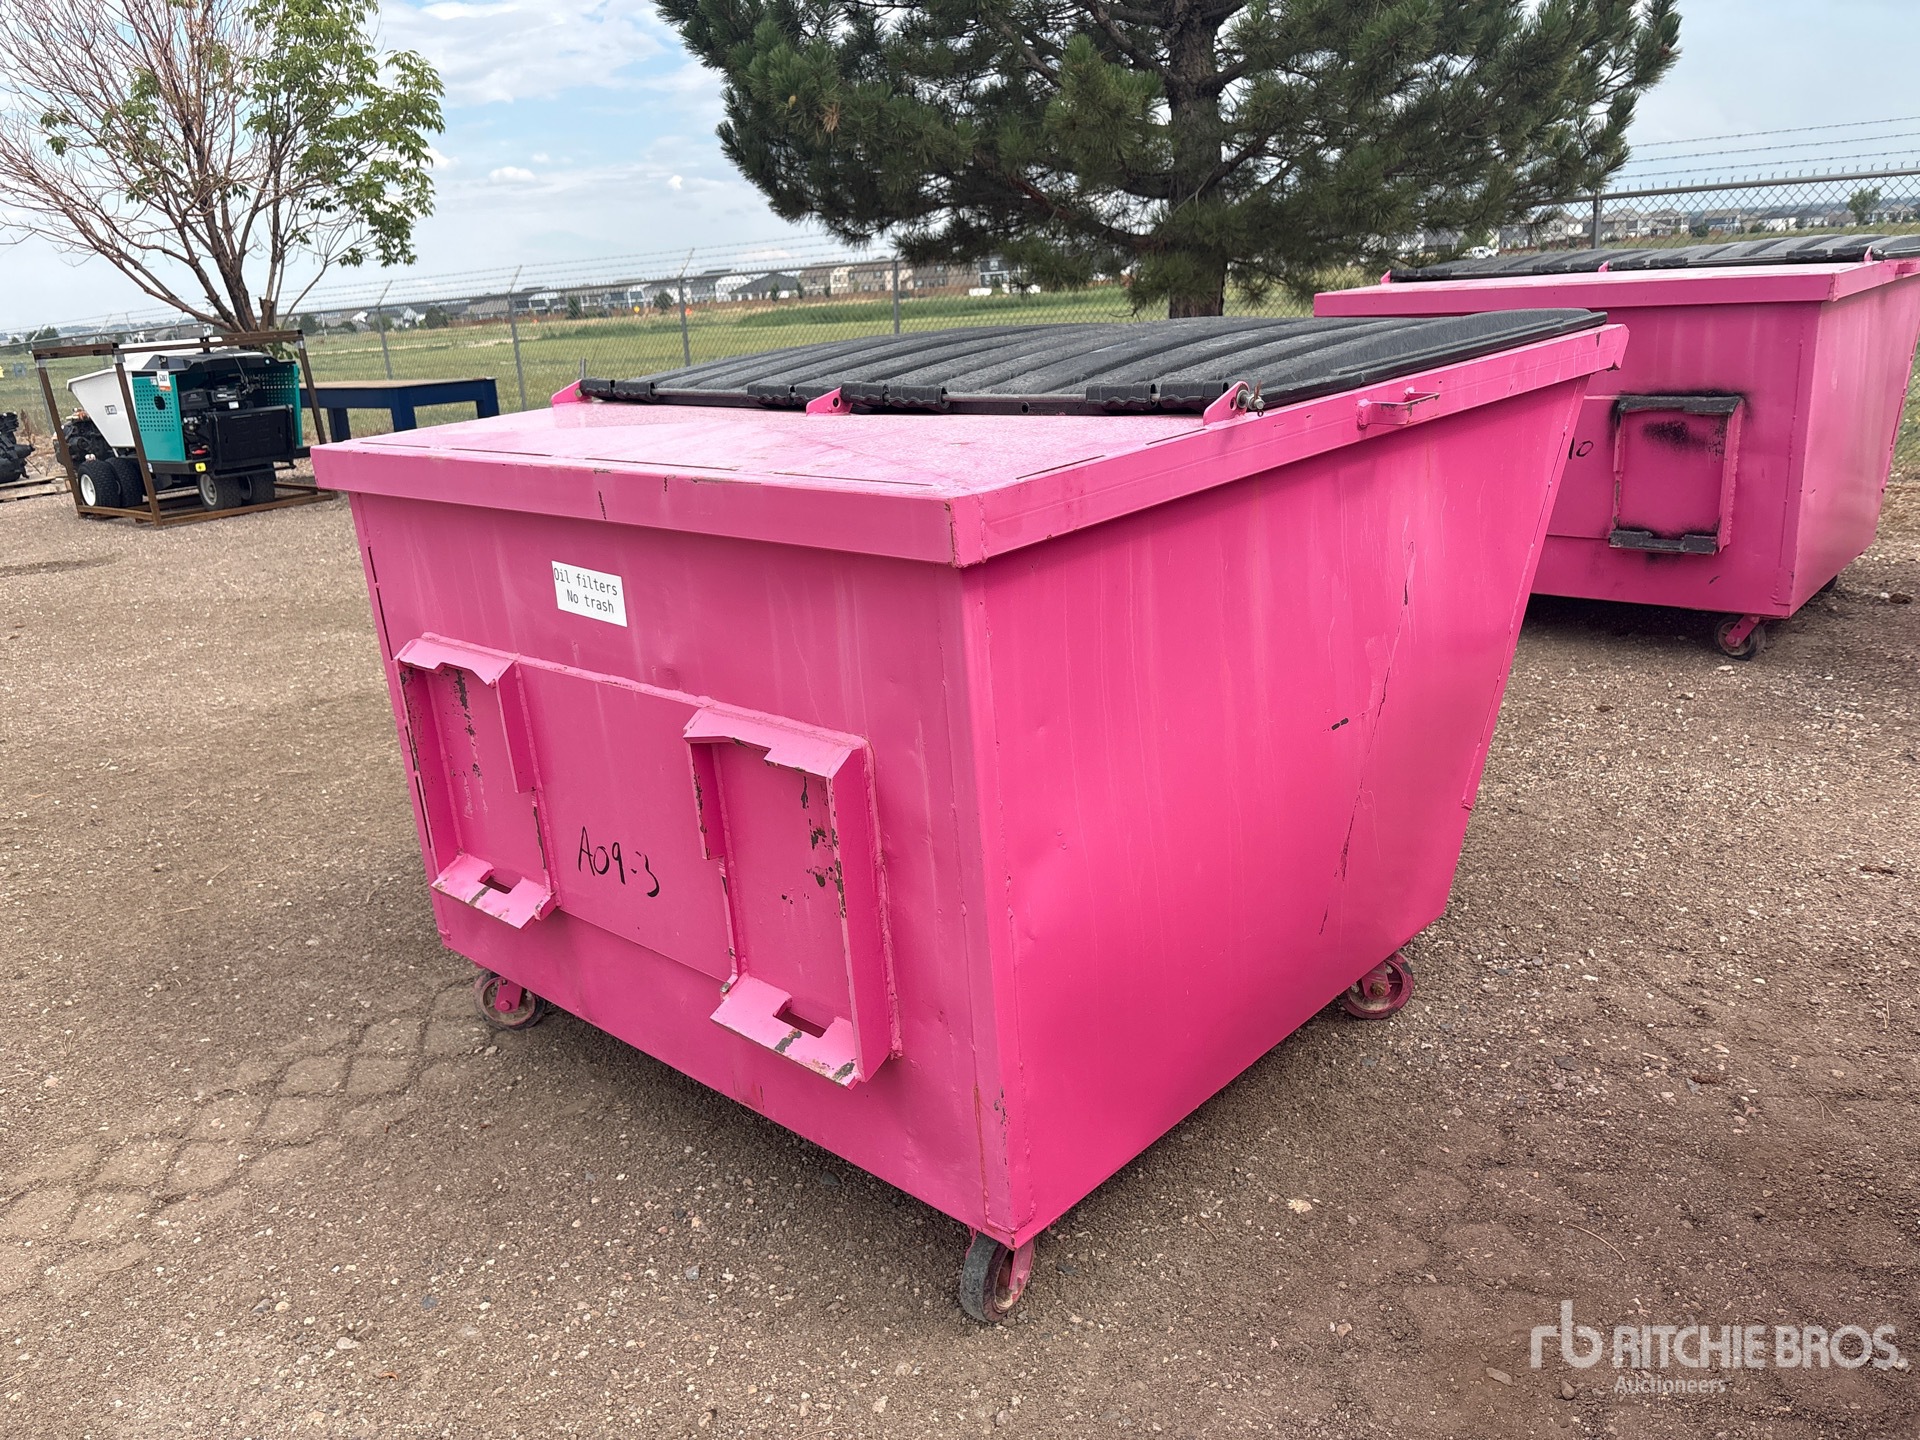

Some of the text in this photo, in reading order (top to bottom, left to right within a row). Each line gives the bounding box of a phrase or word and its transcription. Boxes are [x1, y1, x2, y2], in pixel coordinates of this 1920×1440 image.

[553, 567, 618, 596] Oil filters
[566, 588, 615, 614] No trash
[578, 826, 660, 898] A09-3
